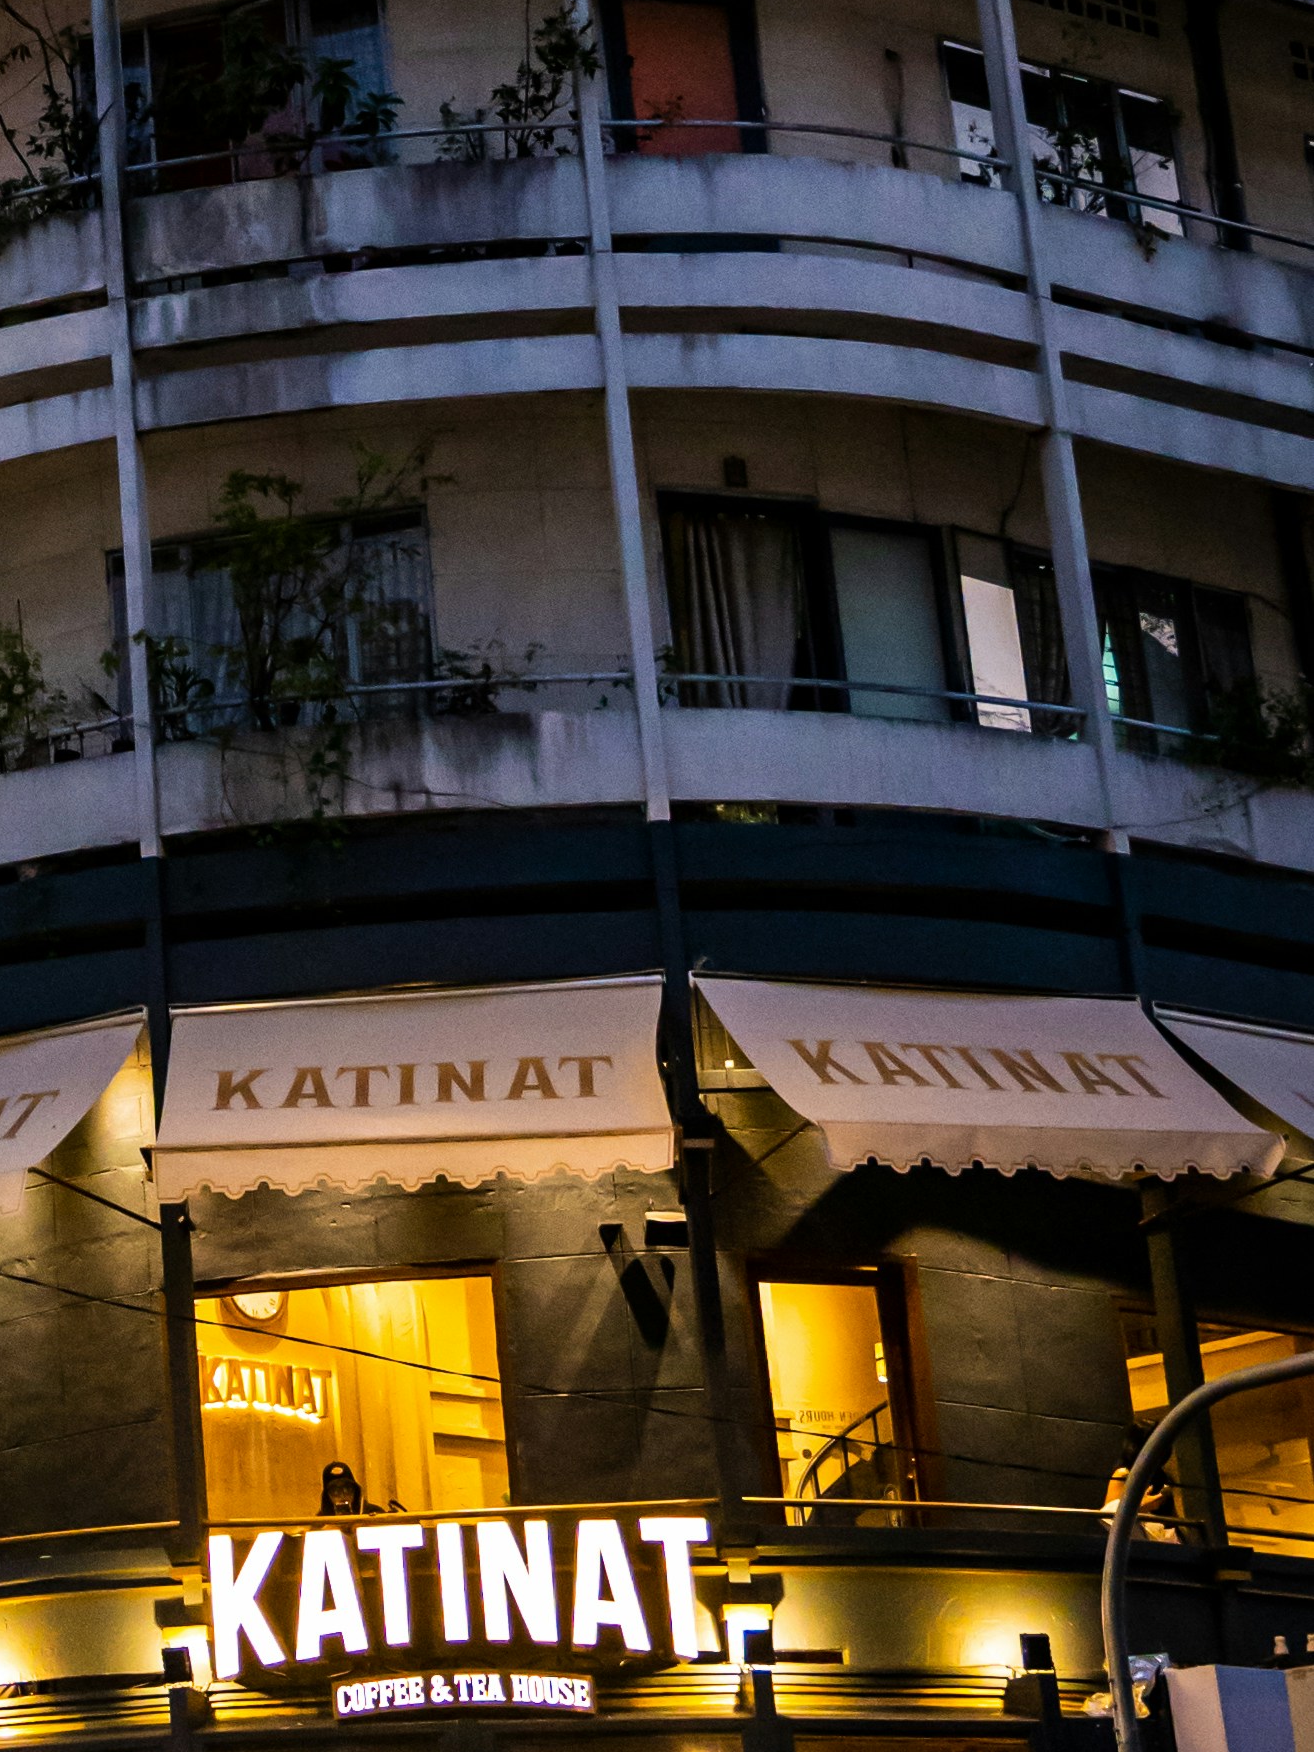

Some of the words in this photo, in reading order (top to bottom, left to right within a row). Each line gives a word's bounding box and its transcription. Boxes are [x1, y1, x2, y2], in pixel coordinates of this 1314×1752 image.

[212, 1055, 615, 1111] KATINAT
[786, 1038, 1168, 1099] KATINAT
[202, 1356, 332, 1420] KATINAT
[207, 1516, 712, 1681] KATINAT
[336, 1676, 425, 1714] COFFEE
[430, 1674, 454, 1703] &
[453, 1674, 506, 1702] TEA
[510, 1674, 591, 1708] HOUSE
